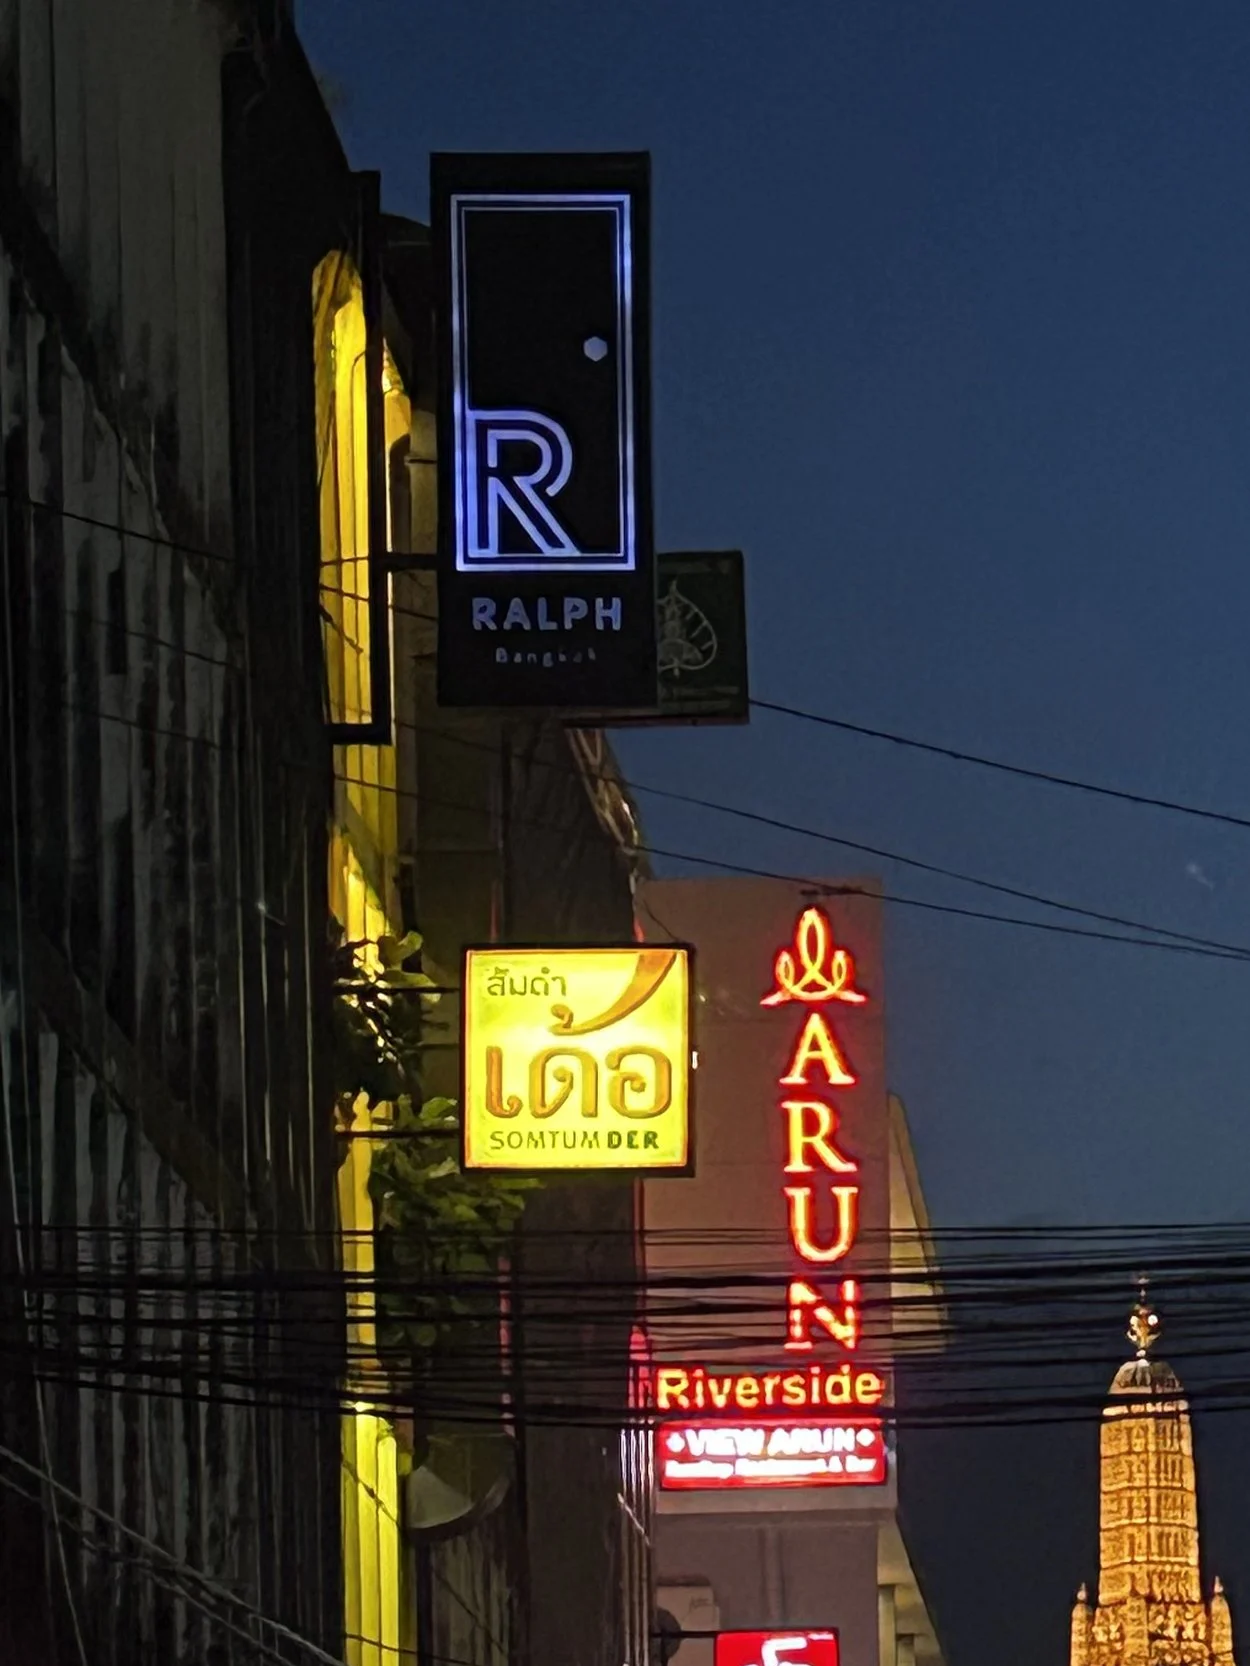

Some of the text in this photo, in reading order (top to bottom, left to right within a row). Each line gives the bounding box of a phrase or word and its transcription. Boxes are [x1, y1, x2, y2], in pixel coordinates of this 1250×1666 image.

[471, 597, 623, 631] RALPH
[779, 1011, 860, 1352] ARUN
[656, 1364, 884, 1409] Riverside
